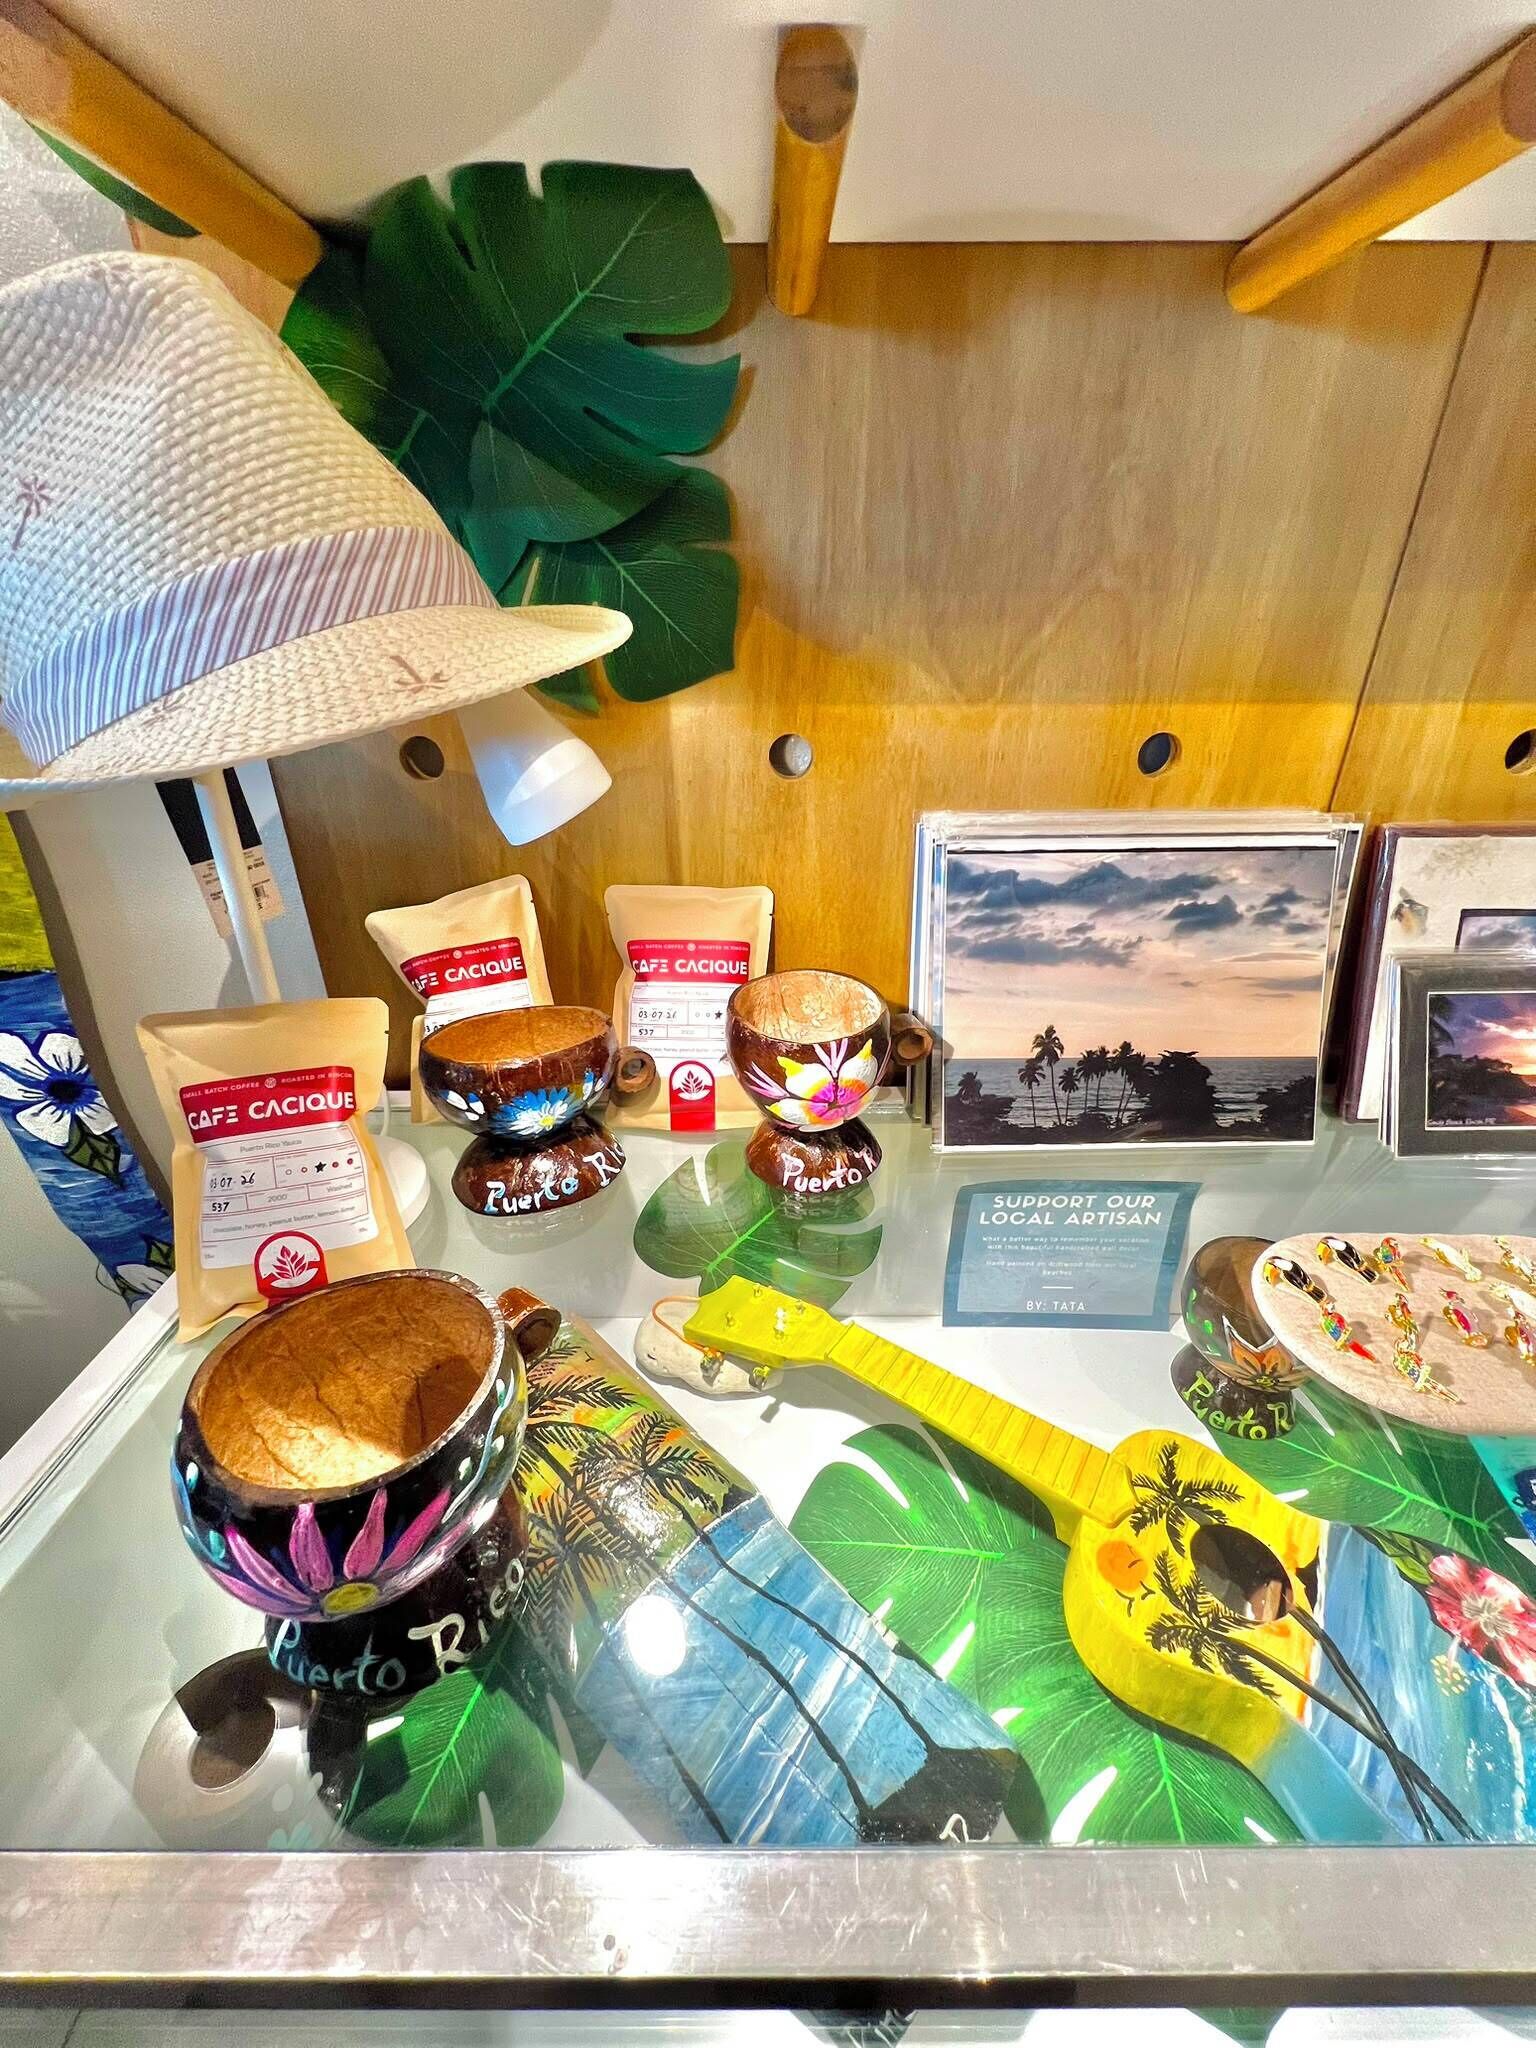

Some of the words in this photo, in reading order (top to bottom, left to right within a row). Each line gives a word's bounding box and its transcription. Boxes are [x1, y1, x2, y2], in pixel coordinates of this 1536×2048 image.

[412, 971, 439, 992] AFE
[444, 957, 523, 982] CACIQUE
[632, 959, 669, 973] CAFE
[675, 959, 747, 975] CACIQUE
[205, 1086, 228, 1095] BATCH
[230, 1082, 260, 1091] COFFEE
[281, 1074, 315, 1083] ROASTED
[188, 1105, 239, 1130] CAFE
[248, 1091, 354, 1119] CACIQUE
[240, 1172, 255, 1185] 26
[780, 1152, 863, 1193] Puerto
[484, 1173, 580, 1214] Puerto
[993, 1195, 1097, 1208] SUPPORT
[1107, 1195, 1156, 1208] OUR
[211, 1201, 230, 1212] 537
[979, 1212, 1055, 1225] LOCAL
[1063, 1212, 1161, 1225] ARTISAN
[1026, 1300, 1047, 1311] BY:
[1052, 1300, 1086, 1311] TATA
[1183, 1370, 1267, 1440] Puerto
[268, 1617, 407, 1695] Puerto
[407, 1556, 525, 1678] Rico
